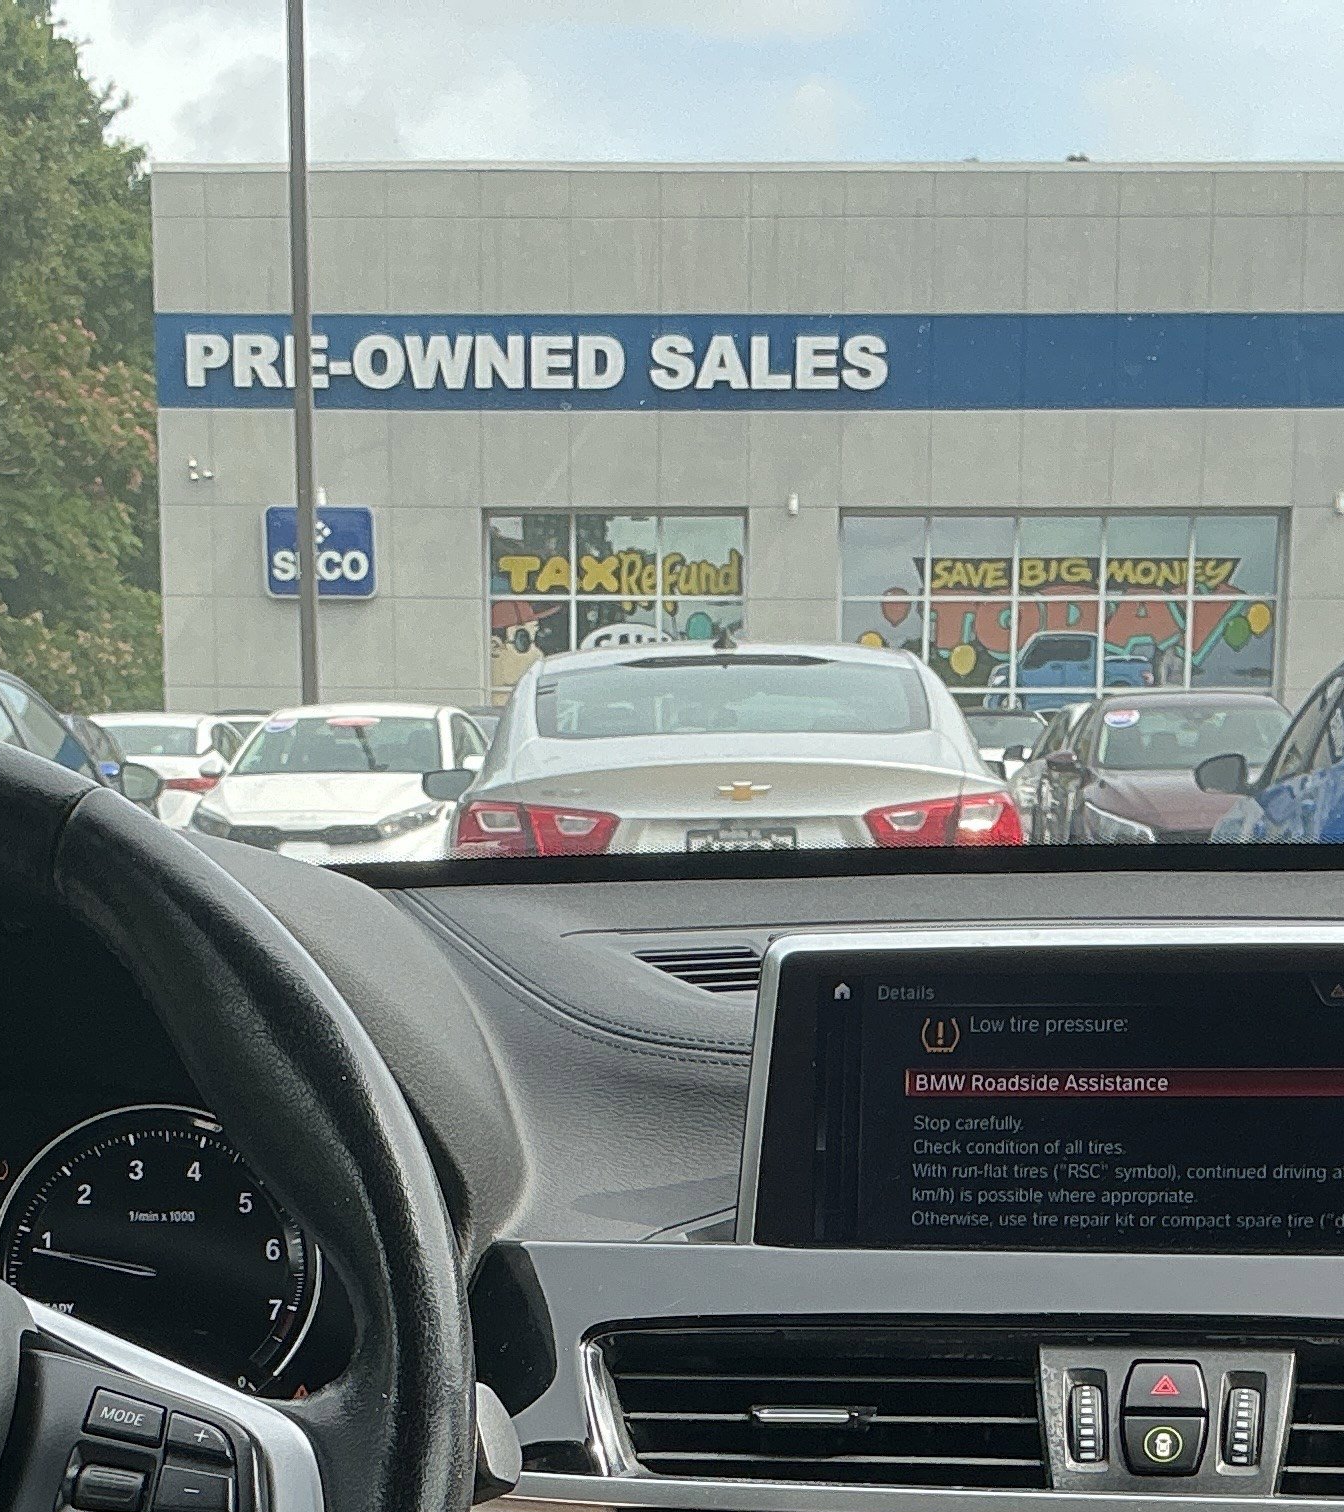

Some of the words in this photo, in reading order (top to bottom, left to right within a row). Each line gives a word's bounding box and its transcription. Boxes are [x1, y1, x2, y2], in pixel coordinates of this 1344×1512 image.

[185, 333, 624, 390] PRE-OWNED
[649, 333, 889, 391] SALES
[272, 550, 370, 581] SCO
[932, 560, 1008, 588] SAVE
[1019, 558, 1093, 587] BIG
[1106, 559, 1234, 587] MONEY
[499, 555, 620, 593] TAX
[619, 547, 745, 615] Refund
[878, 984, 935, 1001] Details
[970, 1016, 1004, 1033] Low
[1010, 1015, 1040, 1033] tire
[1045, 1018, 1129, 1036] pressure:
[915, 1074, 965, 1092] BMW
[971, 1074, 1059, 1092] Roadside
[1064, 1074, 1169, 1092] Assistance
[913, 1115, 950, 1132] Stop
[956, 1115, 1024, 1132] carefully.
[913, 1138, 961, 1155] Check
[966, 1138, 1039, 1155] condition
[1044, 1138, 1061, 1155] of
[1065, 1139, 1083, 1155] all
[1088, 1139, 1126, 1155] tires.
[128, 1160, 145, 1181] 3
[186, 1160, 203, 1182] 4
[912, 1163, 948, 1179] With
[952, 1163, 1008, 1179] run-flat
[1013, 1164, 1049, 1179] tires
[1114, 1163, 1182, 1181] symbol),
[1186, 1164, 1267, 1180] continued
[1272, 1164, 1327, 1183] driving
[75, 1183, 92, 1205] 2
[238, 1192, 253, 1213] 5
[912, 1186, 955, 1205] km/h)
[960, 1187, 972, 1202] is
[977, 1187, 1043, 1205] possible
[1047, 1187, 1096, 1203] where
[169, 1210, 196, 1222] 1000
[911, 1209, 993, 1228] Otherwise,
[999, 1213, 1027, 1228] use
[1032, 1211, 1058, 1228] tire
[1063, 1211, 1110, 1229] repair
[1115, 1210, 1135, 1228] kit
[1140, 1215, 1156, 1228] or
[1161, 1213, 1231, 1230] compact
[1236, 1214, 1283, 1230] spare
[1287, 1213, 1314, 1229] tire
[41, 1231, 52, 1249] 1
[265, 1238, 281, 1261] 6
[268, 1299, 283, 1321] 7
[99, 1406, 145, 1427] MODE
